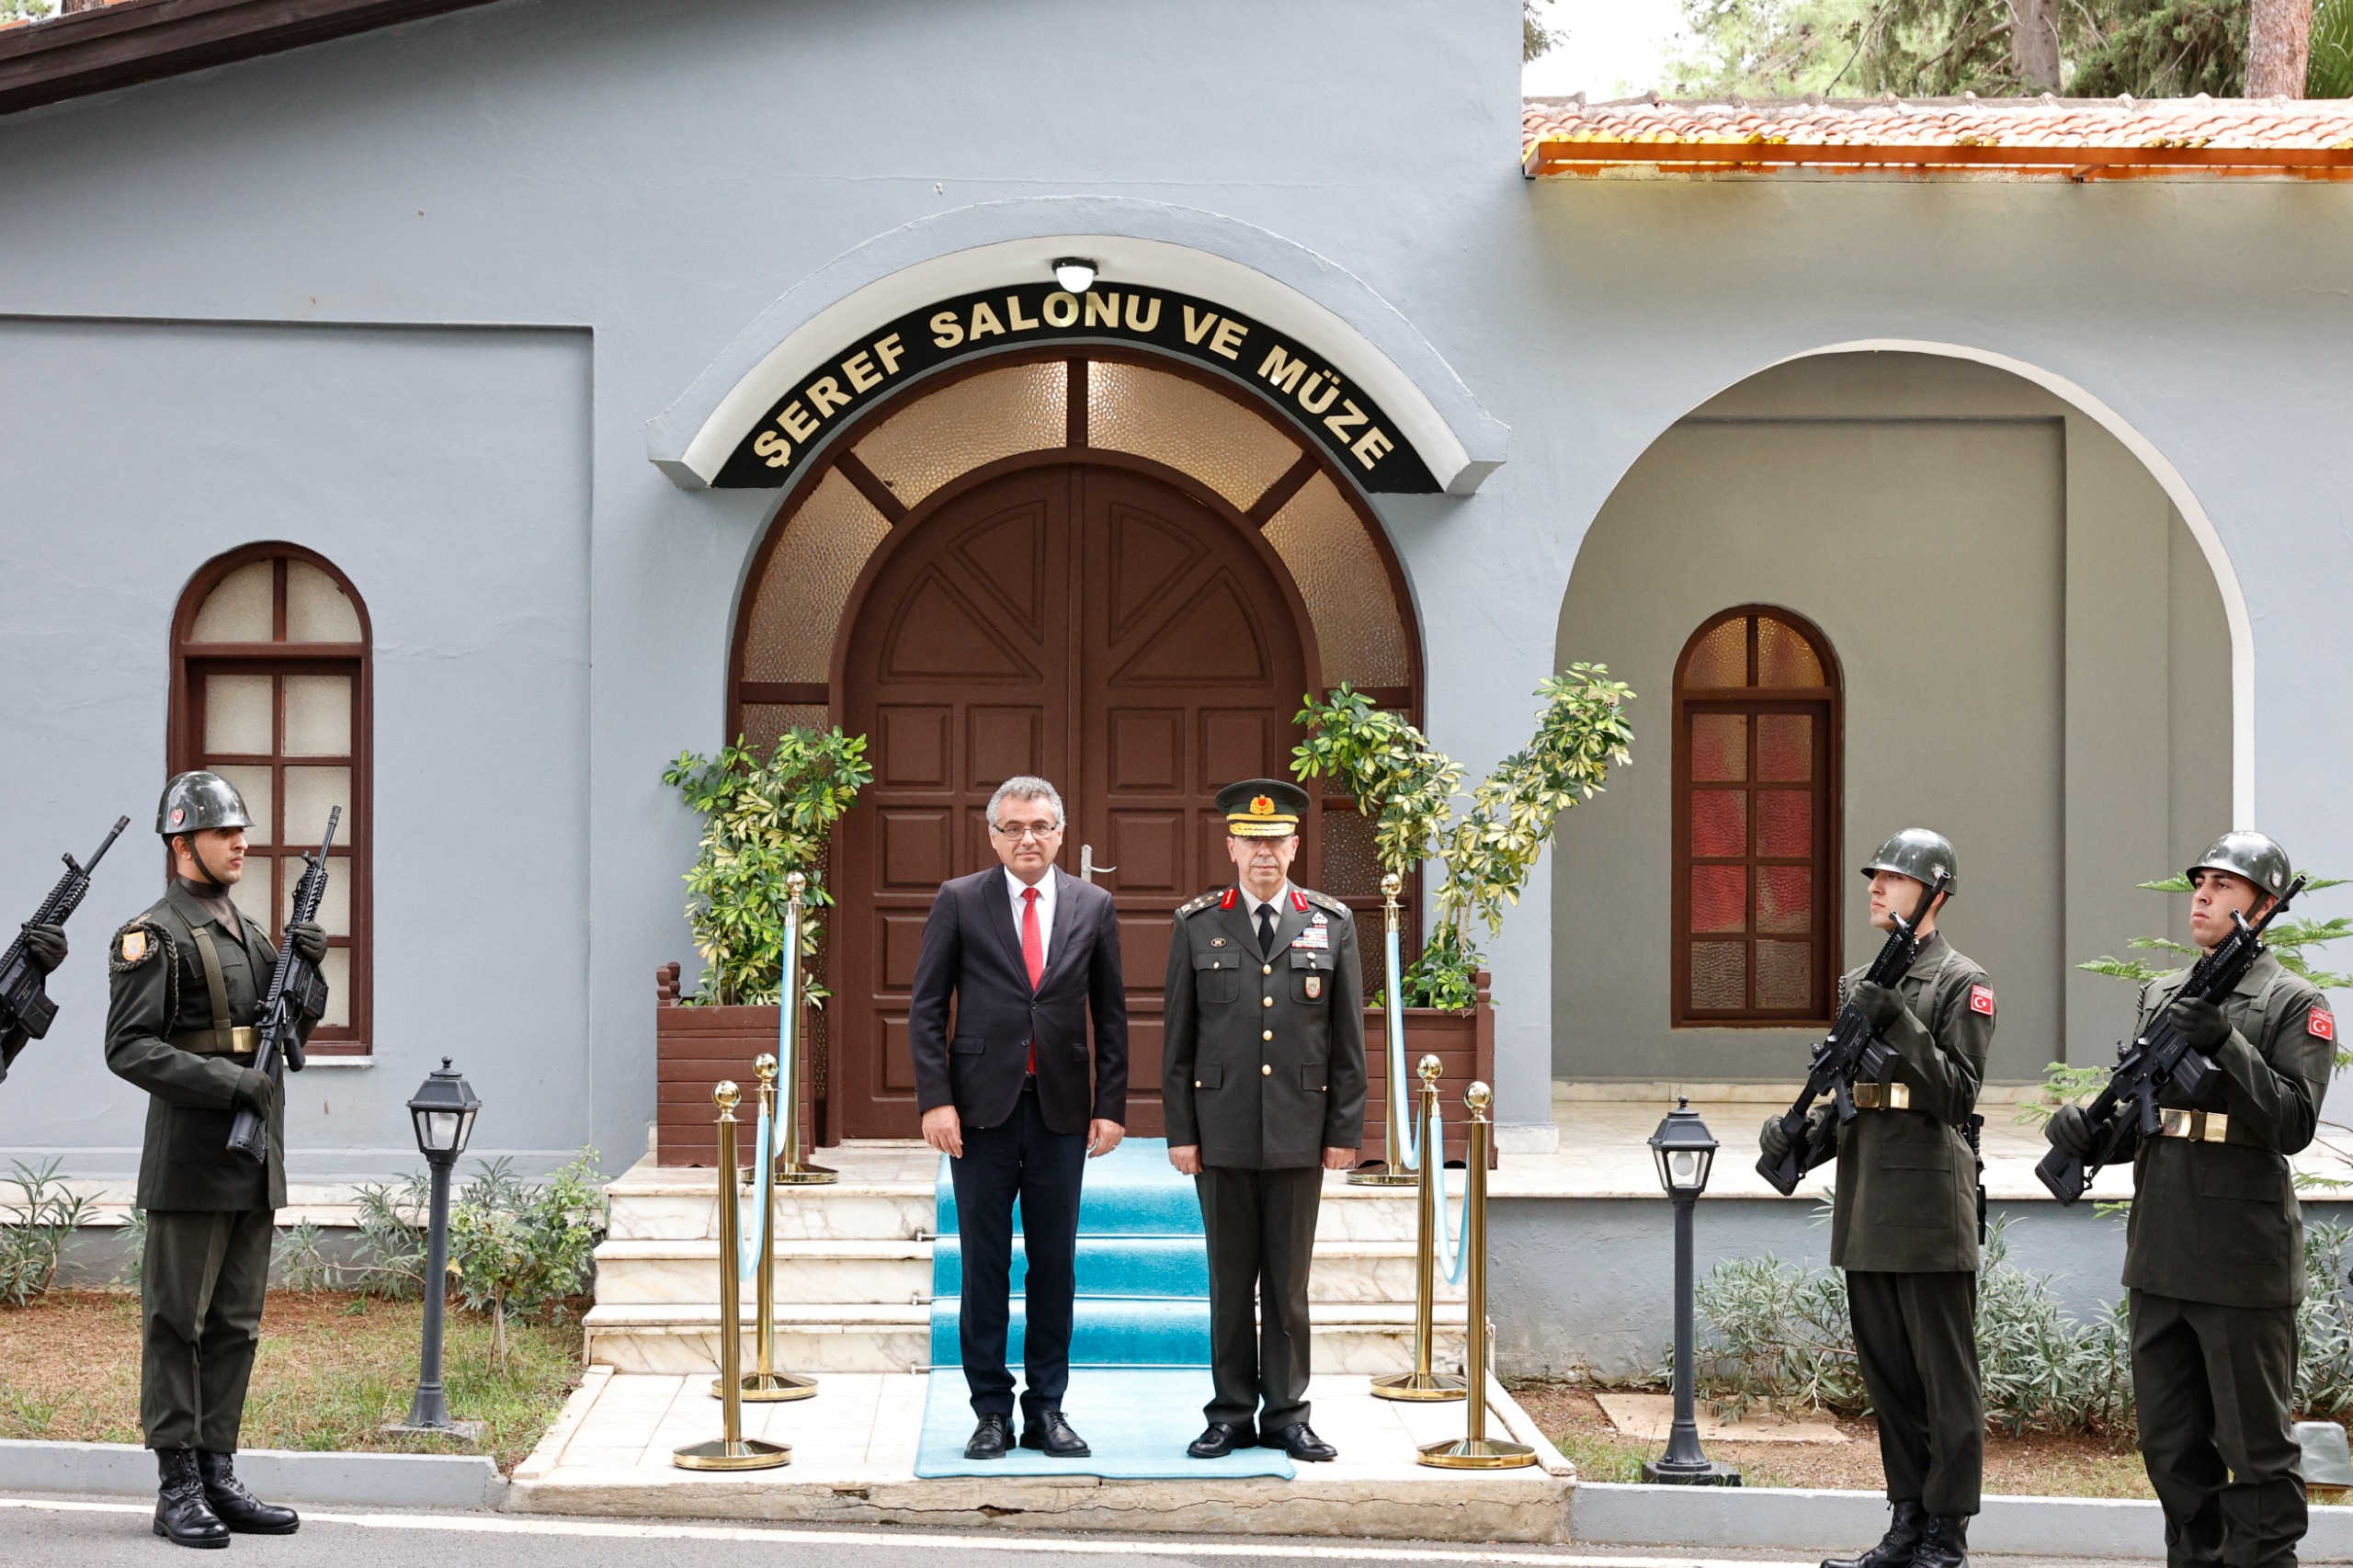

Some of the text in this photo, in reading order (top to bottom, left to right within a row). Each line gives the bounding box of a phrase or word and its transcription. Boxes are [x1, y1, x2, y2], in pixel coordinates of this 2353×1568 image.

[754, 291, 1394, 471] ŞEREF SALONU VE MÜZE
